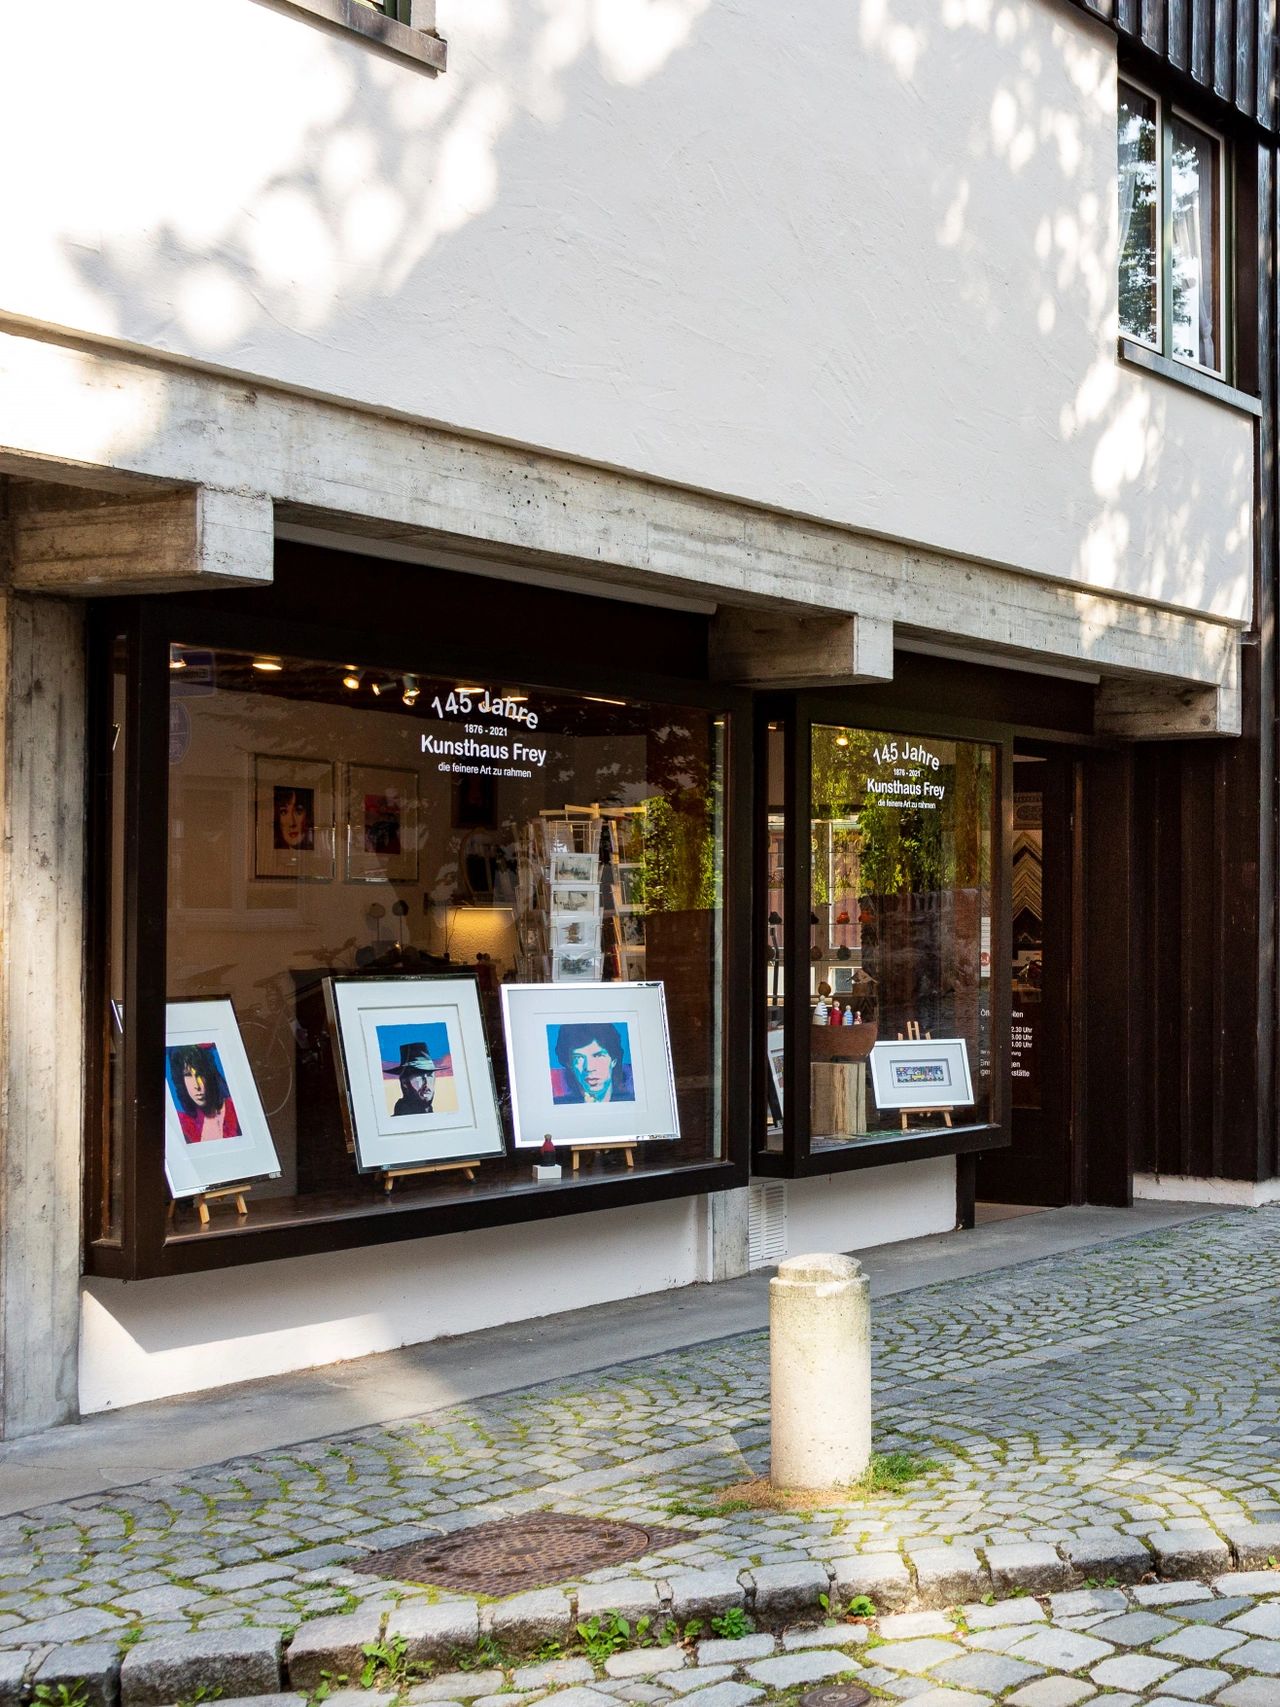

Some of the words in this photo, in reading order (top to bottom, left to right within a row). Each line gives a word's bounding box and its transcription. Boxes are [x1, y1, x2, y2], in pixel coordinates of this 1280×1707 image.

[431, 691, 472, 718] 145
[478, 691, 539, 729] Jahre
[464, 723, 483, 735] 1876
[489, 726, 508, 736] 2021
[421, 734, 509, 760] Kunsthaus
[513, 743, 546, 766] Frey
[873, 742, 898, 765] 145
[902, 742, 940, 771] Jahre
[438, 762, 450, 772] die
[452, 763, 479, 774] feinere
[480, 765, 491, 775] Art
[493, 768, 502, 776] zu
[503, 768, 532, 778] rahmen
[867, 778, 921, 795] Kunsthaus
[924, 782, 945, 800] Frey
